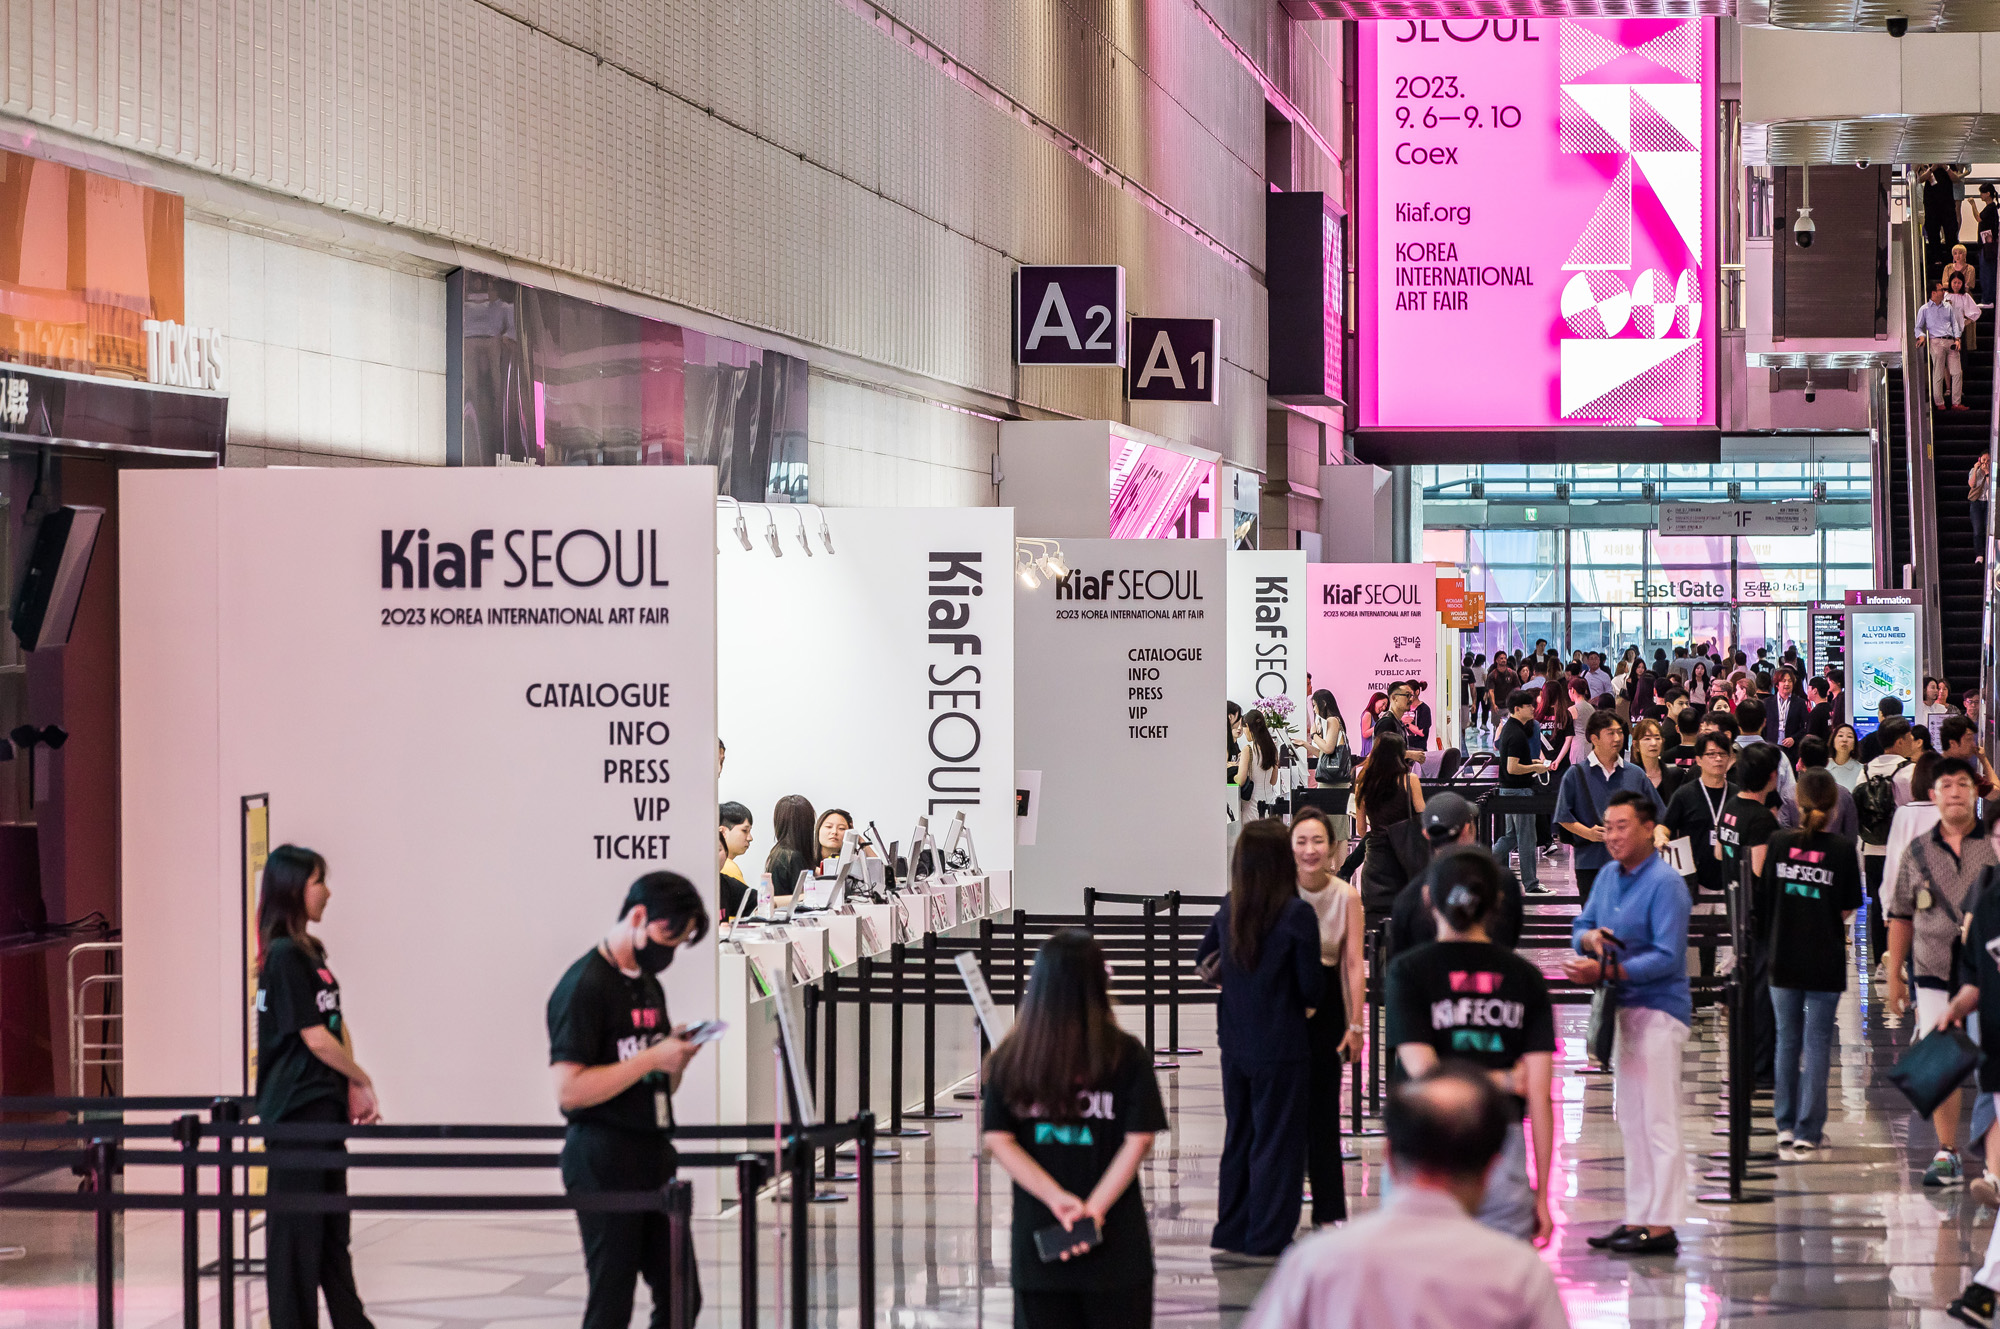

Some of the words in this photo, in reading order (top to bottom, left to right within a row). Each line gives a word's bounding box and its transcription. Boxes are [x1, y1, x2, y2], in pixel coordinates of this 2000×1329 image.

[1396, 76, 1465, 98] 2023.
[1396, 142, 1458, 164] Coex
[1396, 202, 1470, 225] Kiaf.org
[1396, 242, 1458, 261] KOREA
[1396, 267, 1533, 286] INTERNATIONAL
[1396, 292, 1427, 311] ART
[1433, 292, 1468, 311] FAIR
[1025, 282, 1112, 350] A2
[142, 319, 223, 390] TICKETS
[1136, 330, 1205, 389] A1
[1734, 511, 1752, 527] 1F
[381, 528, 494, 588] Kiaf
[504, 529, 669, 587] SEOUL
[1056, 569, 1114, 600] Kiaf
[1119, 570, 1203, 600] SEOUL
[1323, 584, 1362, 604] Kiaf
[1365, 584, 1421, 604] SEOUL
[1634, 581, 1676, 597] East
[1680, 580, 1724, 597] Gate
[1743, 581, 1771, 598] 동문
[928, 552, 983, 655] Kiaf
[1256, 577, 1288, 638] Kiaf
[1866, 596, 1911, 604] information
[381, 608, 425, 625] 2023
[431, 608, 483, 625] KOREA
[488, 608, 603, 625] INTERNATIONAL
[609, 608, 635, 625] ART
[640, 608, 669, 625] FAIR
[1056, 610, 1079, 619] 2023
[1081, 610, 1108, 619] KOREA
[1111, 610, 1170, 619] INTERNATIONAL
[1172, 610, 1186, 619] ART
[1188, 610, 1204, 619] FAIR
[1393, 636, 1421, 648] 월간미술
[1128, 648, 1202, 661] CATALOGUE
[1384, 653, 1398, 662] Art
[1129, 668, 1159, 681] INFO
[1256, 643, 1287, 699] SEO
[1129, 687, 1163, 700] PRESS
[1874, 675, 1893, 691] GPT
[526, 683, 670, 707] CATALOGUE
[1129, 707, 1147, 719] VIP
[609, 721, 670, 745] INFO
[928, 665, 981, 816] SEOUL
[1129, 726, 1168, 738] TICKET
[604, 759, 670, 783] PRESS
[634, 798, 670, 821] VIP
[594, 835, 670, 859] TICKET
